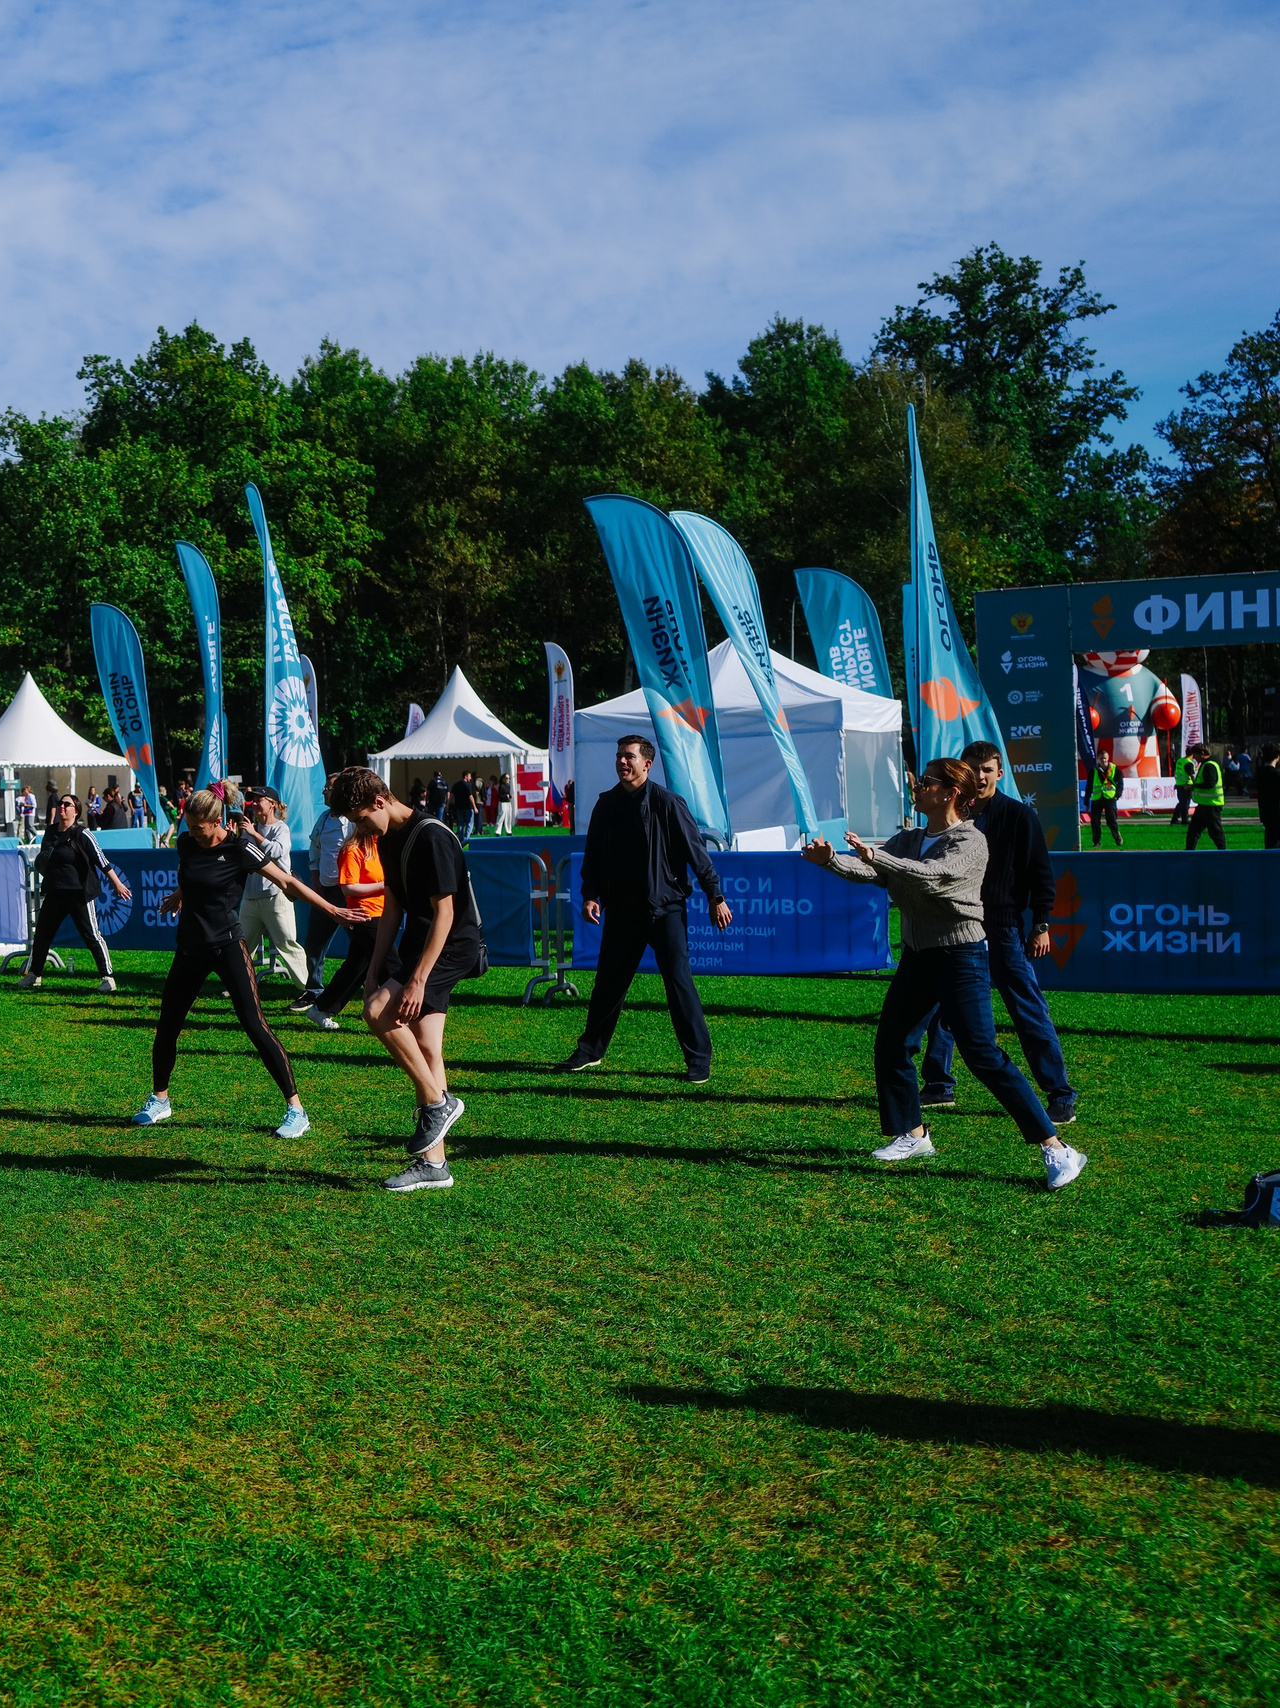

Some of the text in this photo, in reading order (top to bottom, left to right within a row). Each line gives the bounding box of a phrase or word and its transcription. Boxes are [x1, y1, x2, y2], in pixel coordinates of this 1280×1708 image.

[1133, 587, 1280, 635] ФИН
[1016, 661, 1048, 669] ЖИЗНИ
[1018, 655, 1046, 663] ОГОНЬ
[1120, 683, 1134, 702] 1
[1013, 763, 1053, 773] MAER
[140, 869, 179, 888] NOB
[143, 909, 179, 927] CLU
[1109, 903, 1230, 926] ОГОНЬ
[687, 925, 714, 937] ОНД
[688, 941, 744, 952] ОЖИЛЫМ
[1101, 930, 1241, 954] ЖИЗНИ
